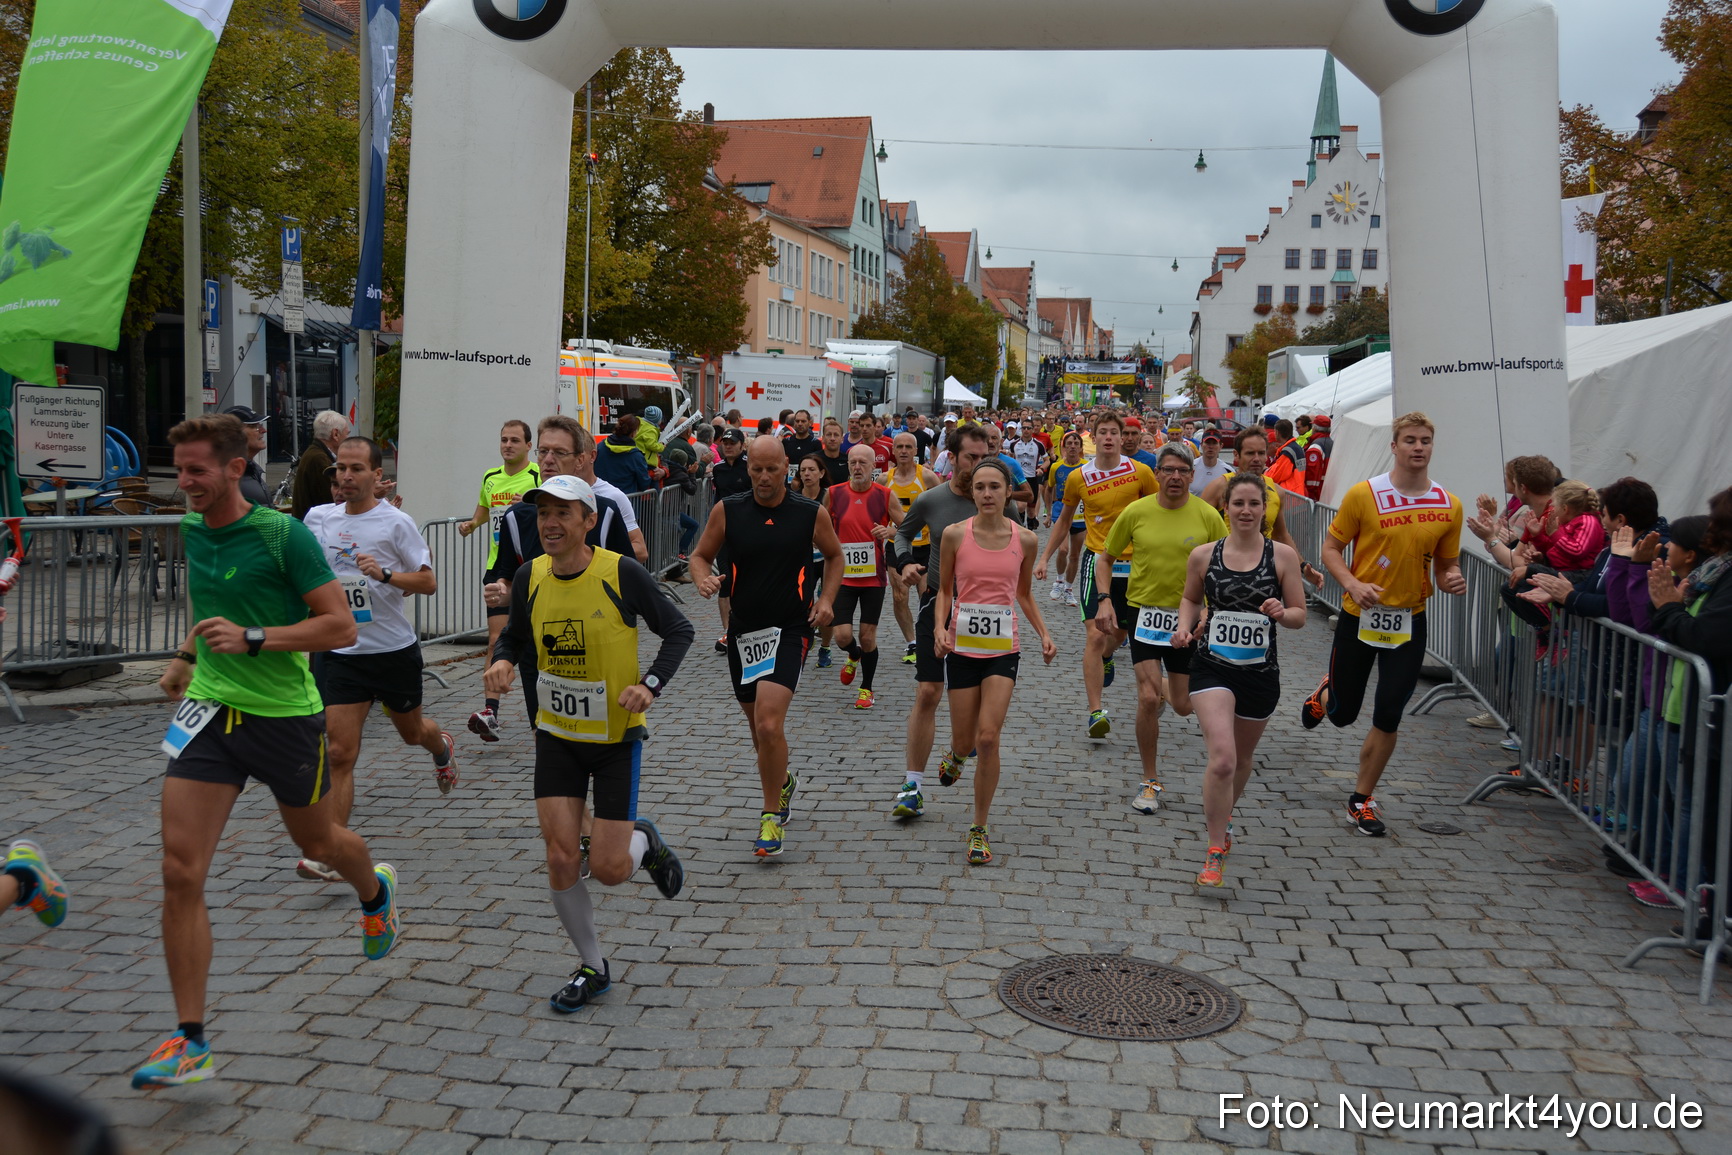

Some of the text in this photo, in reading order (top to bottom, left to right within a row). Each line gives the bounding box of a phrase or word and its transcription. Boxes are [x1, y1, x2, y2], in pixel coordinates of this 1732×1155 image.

[404, 348, 532, 367] www.bmw-laufsport.de
[1421, 357, 1564, 376] www.bmw-laufsport.de
[767, 381, 801, 389] Bayerisches
[20, 394, 100, 408] Fußgänger Richtung
[33, 407, 87, 417] Lammsbräu-
[30, 418, 90, 430] Kreuzung über
[47, 431, 75, 440] Untere
[34, 442, 87, 453] Kaserngasse
[1087, 475, 1139, 496] MAX BÖGL
[1379, 510, 1453, 529] MAX BÖGL
[846, 550, 868, 565] 189
[341, 579, 357, 587] markt
[968, 616, 1001, 636] 531
[1232, 617, 1261, 625] Neumarkt
[1370, 612, 1403, 631] 358
[738, 632, 774, 645] PARTL Neumarkt
[1215, 623, 1264, 646] 3096
[1378, 634, 1391, 642] Jan
[743, 638, 777, 665] 3097
[538, 676, 594, 694] PARTL Neumarkt
[551, 689, 590, 718] 501
